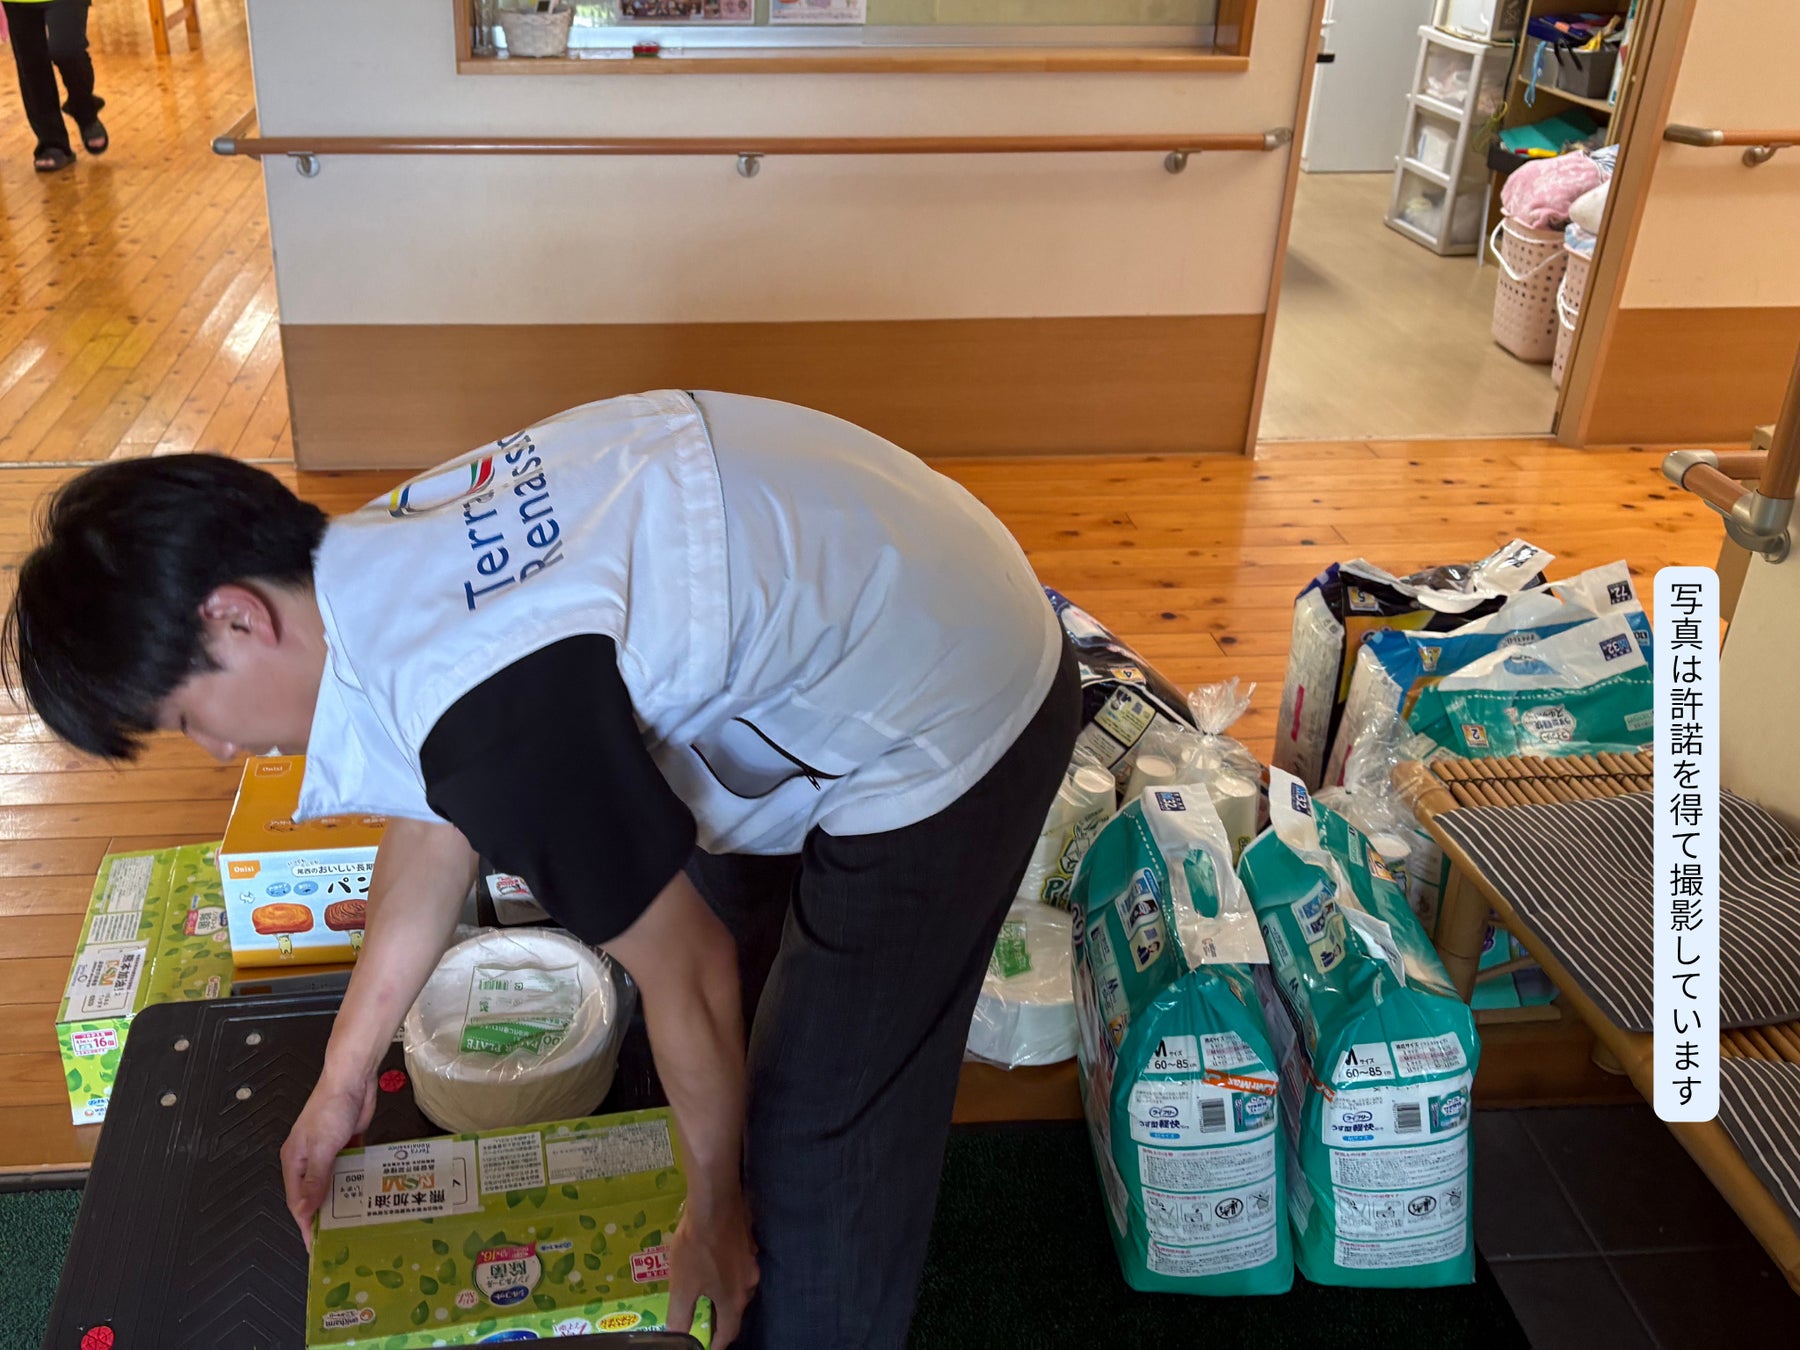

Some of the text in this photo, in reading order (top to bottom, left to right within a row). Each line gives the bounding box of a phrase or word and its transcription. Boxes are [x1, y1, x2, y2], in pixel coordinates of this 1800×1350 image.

[466, 1038, 501, 1053] PLATE
[366, 1190, 446, 1209] 熊本加油!
[490, 1261, 527, 1279] 除菌
[634, 1255, 662, 1271] 16個
